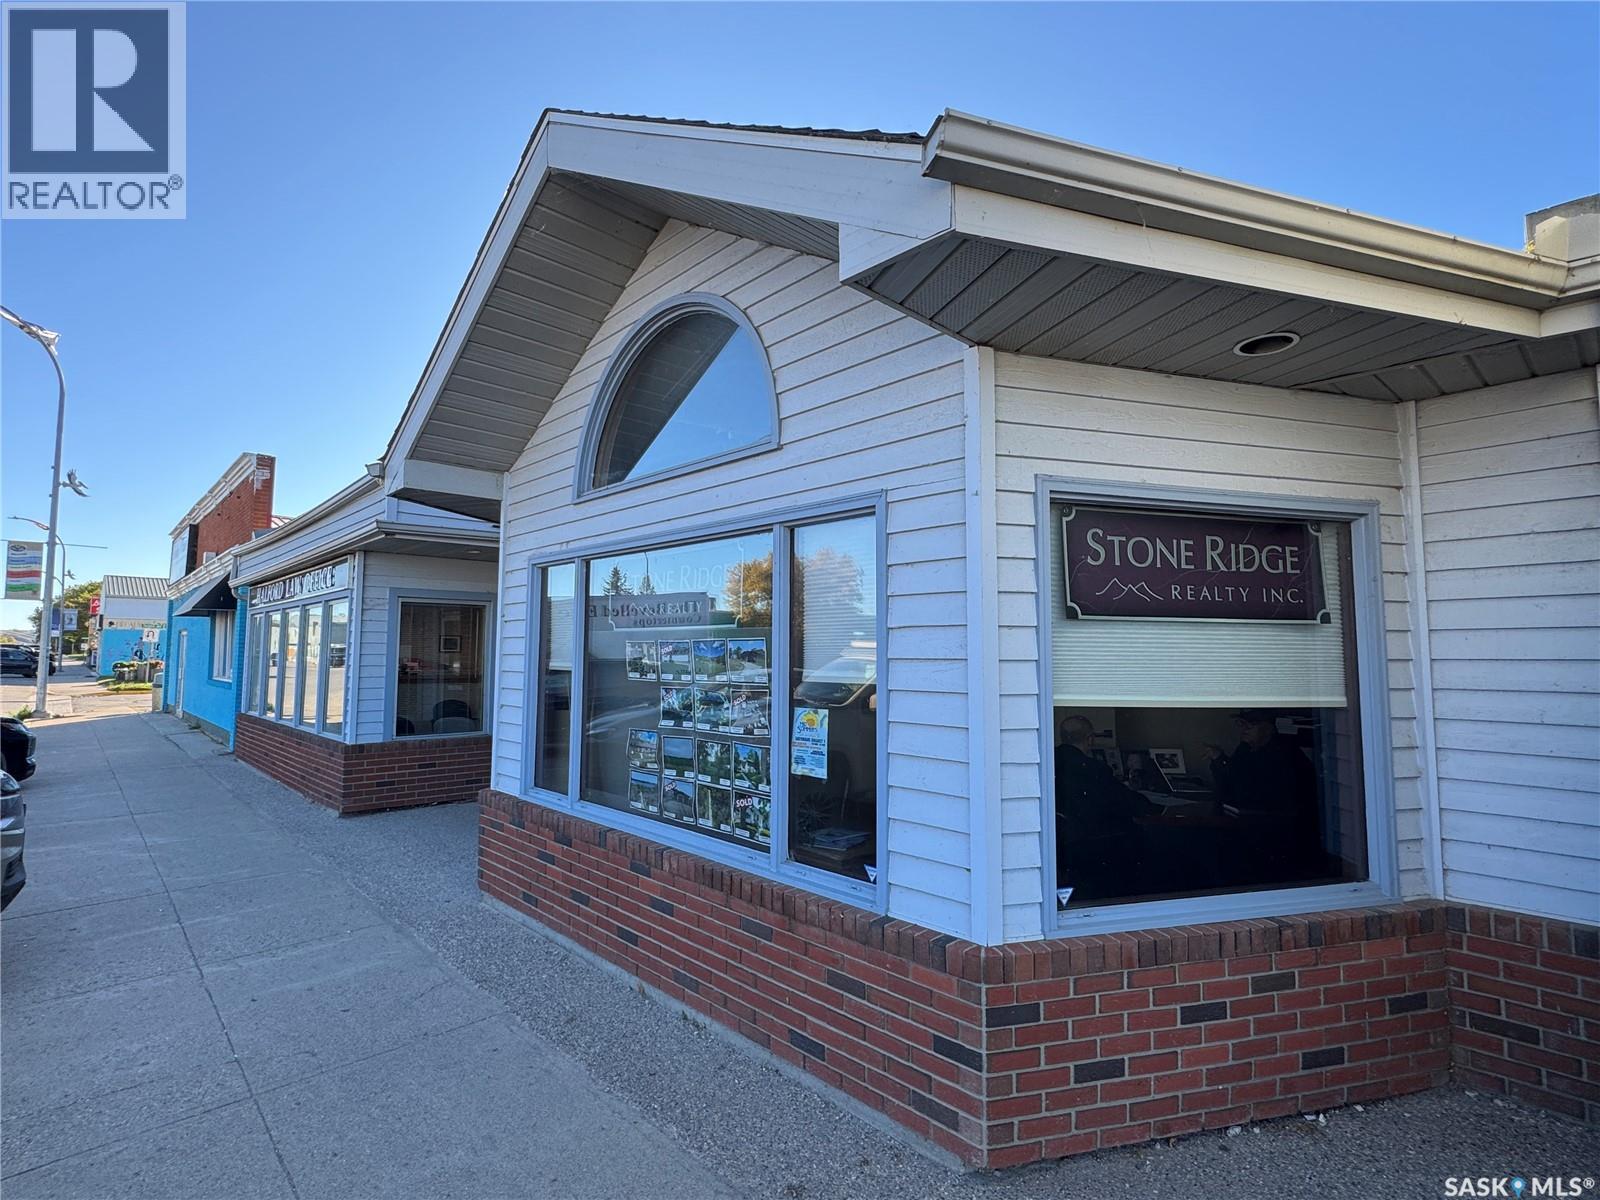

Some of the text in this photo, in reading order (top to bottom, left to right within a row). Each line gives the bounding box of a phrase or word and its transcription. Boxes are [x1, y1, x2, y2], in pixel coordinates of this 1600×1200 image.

[1086, 527, 1301, 574] STONE RIDGE
[256, 581, 284, 604] HALFORD
[285, 576, 303, 598] LAW
[1171, 584, 1304, 604] REALTY INC.
[733, 694, 746, 706] SOLD
[736, 797, 753, 808] SOLD
